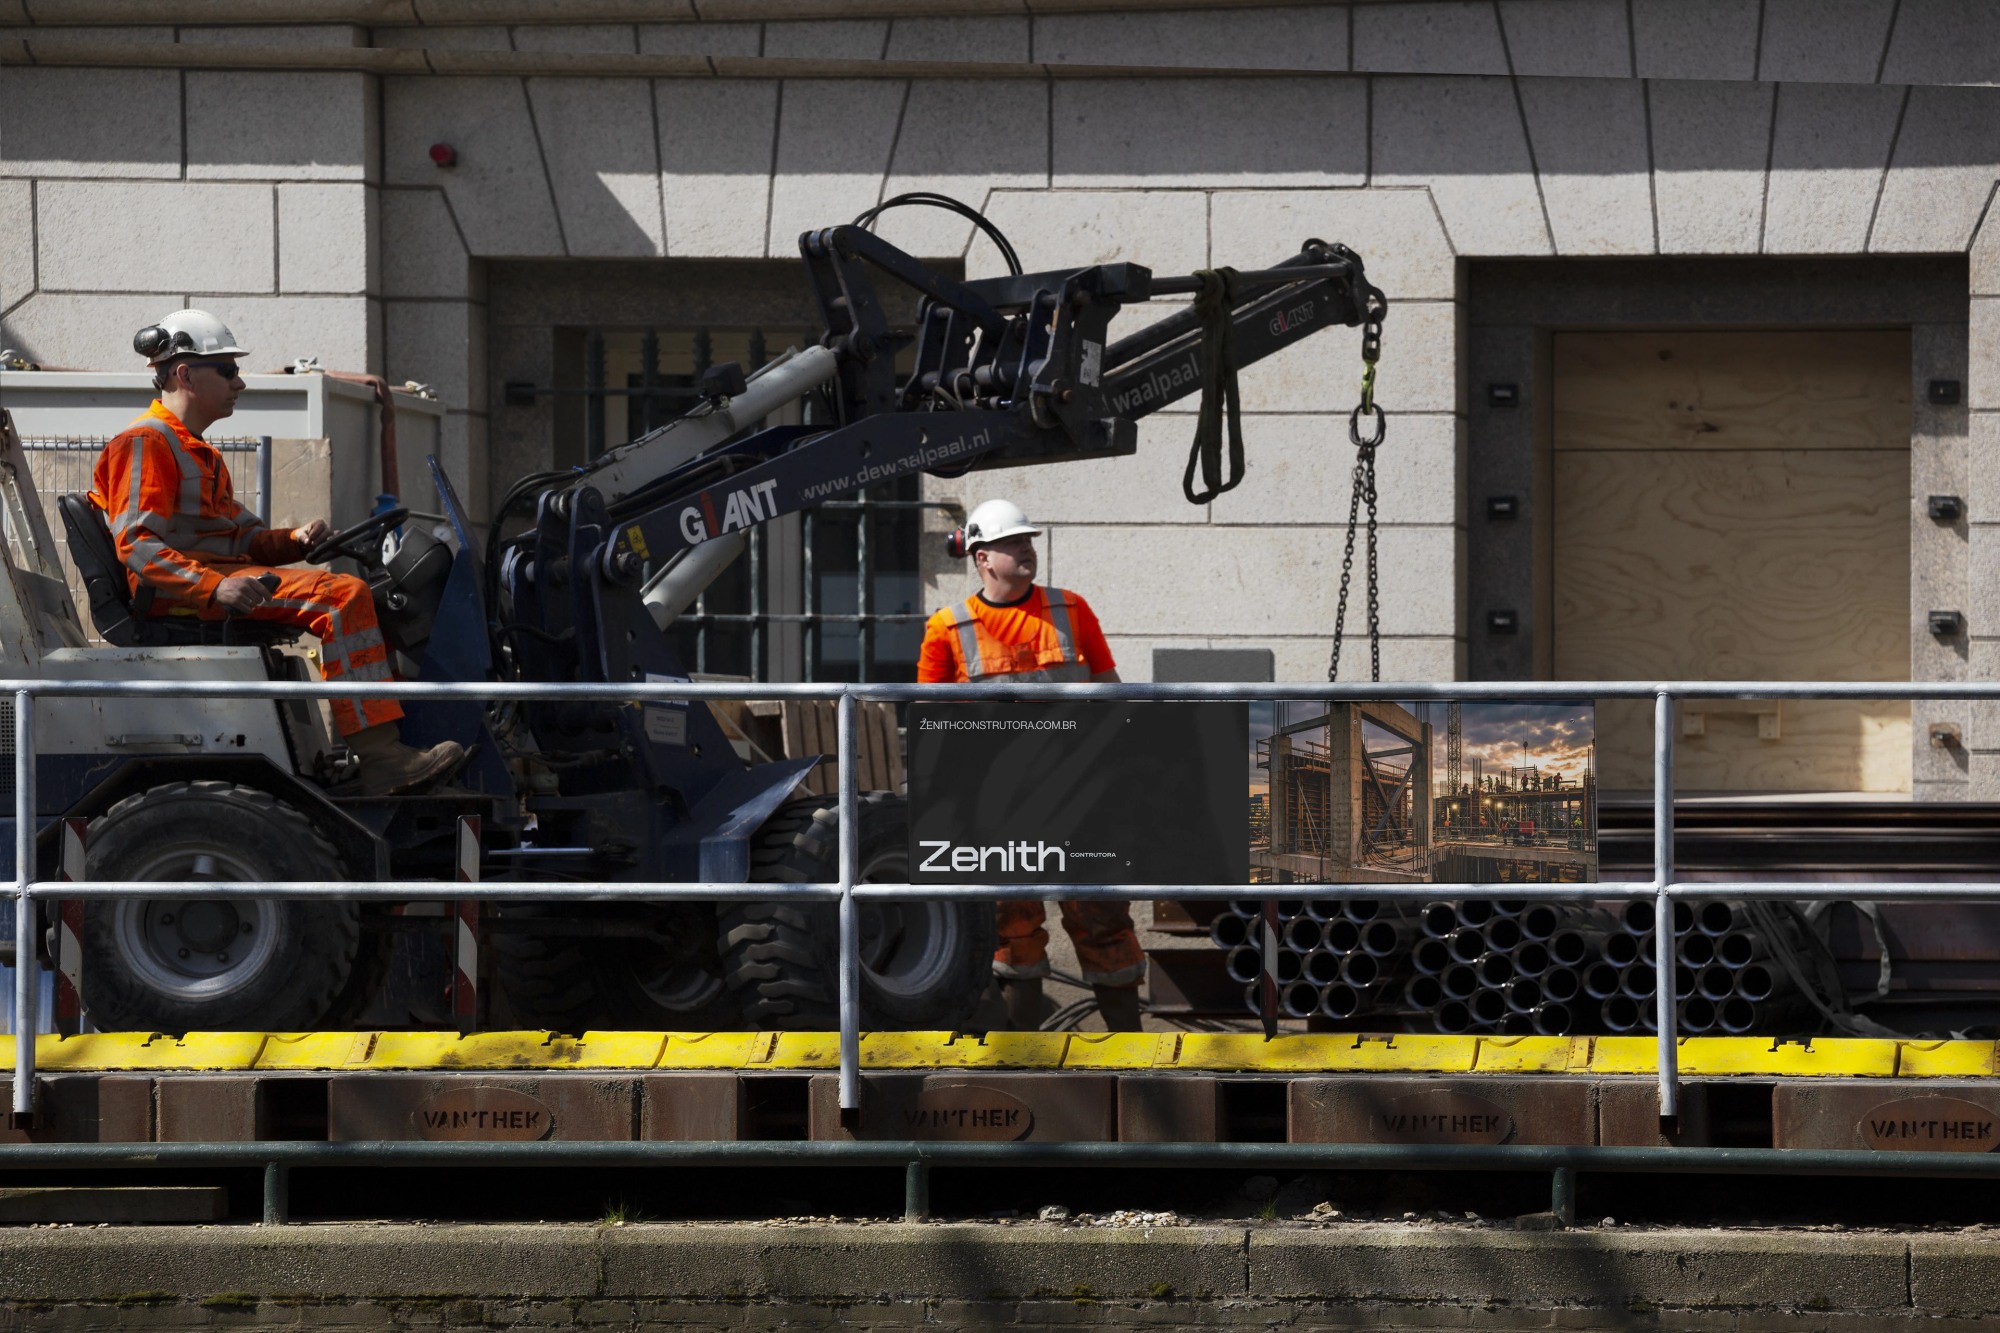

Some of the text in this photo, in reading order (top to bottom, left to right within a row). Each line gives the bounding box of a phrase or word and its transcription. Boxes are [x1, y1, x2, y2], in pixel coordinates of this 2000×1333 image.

[1268, 299, 1315, 337] GIANT
[679, 477, 778, 546] GIANT
[919, 720, 1077, 731] ZENITHCONSTRUTORA.COM.BR
[919, 840, 1066, 872] Zenith
